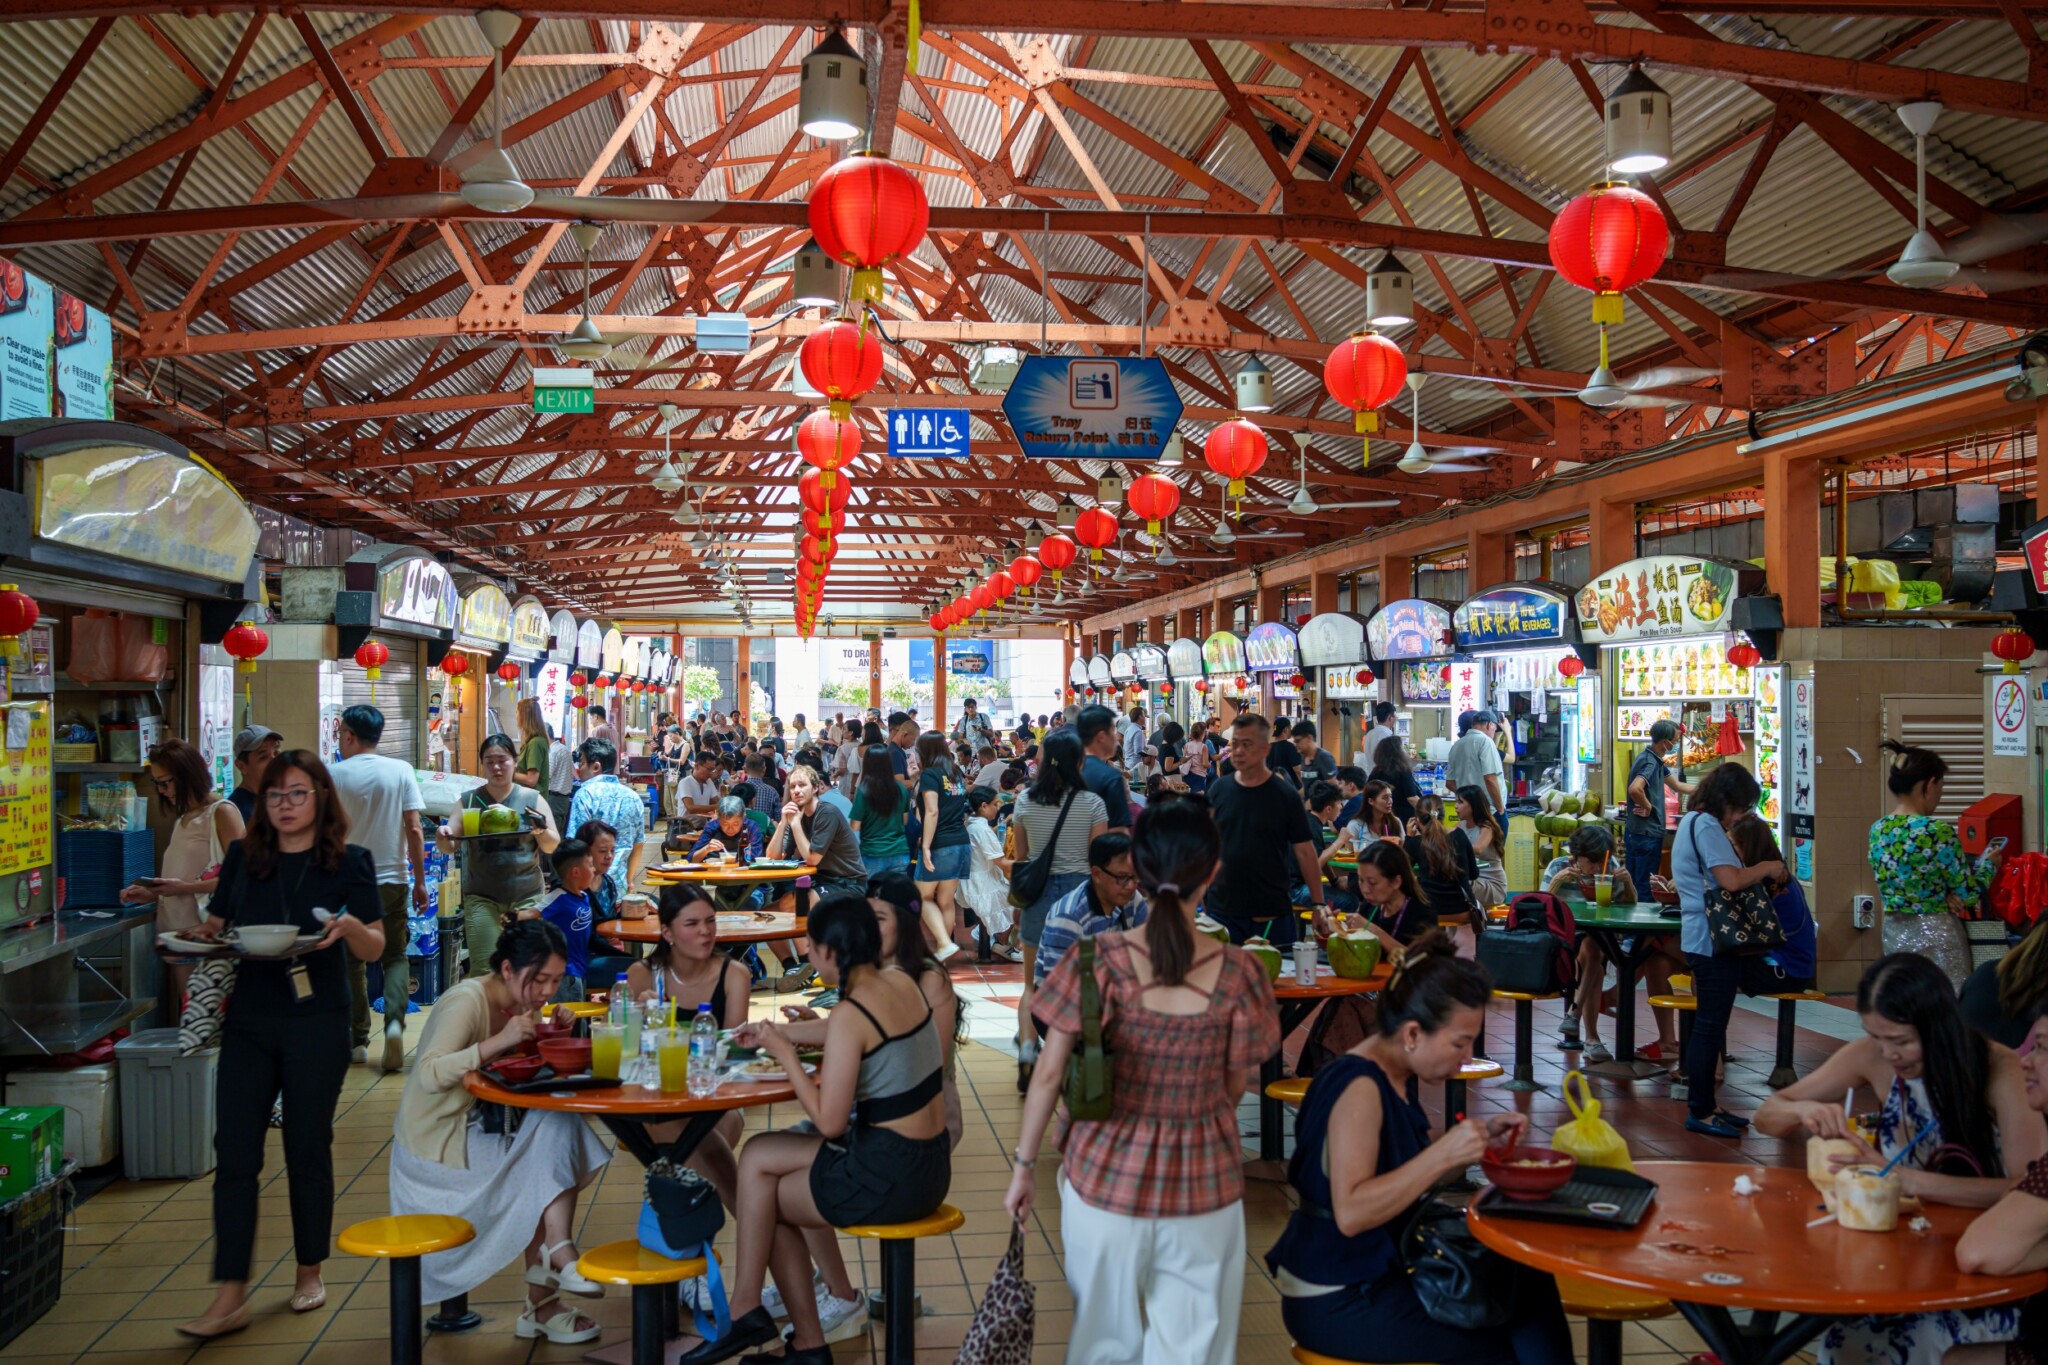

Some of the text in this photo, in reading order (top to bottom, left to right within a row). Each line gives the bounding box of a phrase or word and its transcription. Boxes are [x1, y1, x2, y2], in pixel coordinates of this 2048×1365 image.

[6, 336, 45, 360] Clear your table
[14, 353, 29, 365] avoid
[546, 390, 581, 408] EXIT
[1051, 416, 1082, 430] Tray
[1024, 431, 1109, 443] Return Point
[1521, 617, 1552, 632] BEVERAGES
[1659, 627, 1669, 635] Fish
[1670, 626, 1683, 635] Soup
[843, 649, 870, 658] TO DRA
[544, 667, 559, 713] 甘蔗汁
[1799, 818, 1806, 826] NO
[1795, 826, 1811, 835] TOUTING
